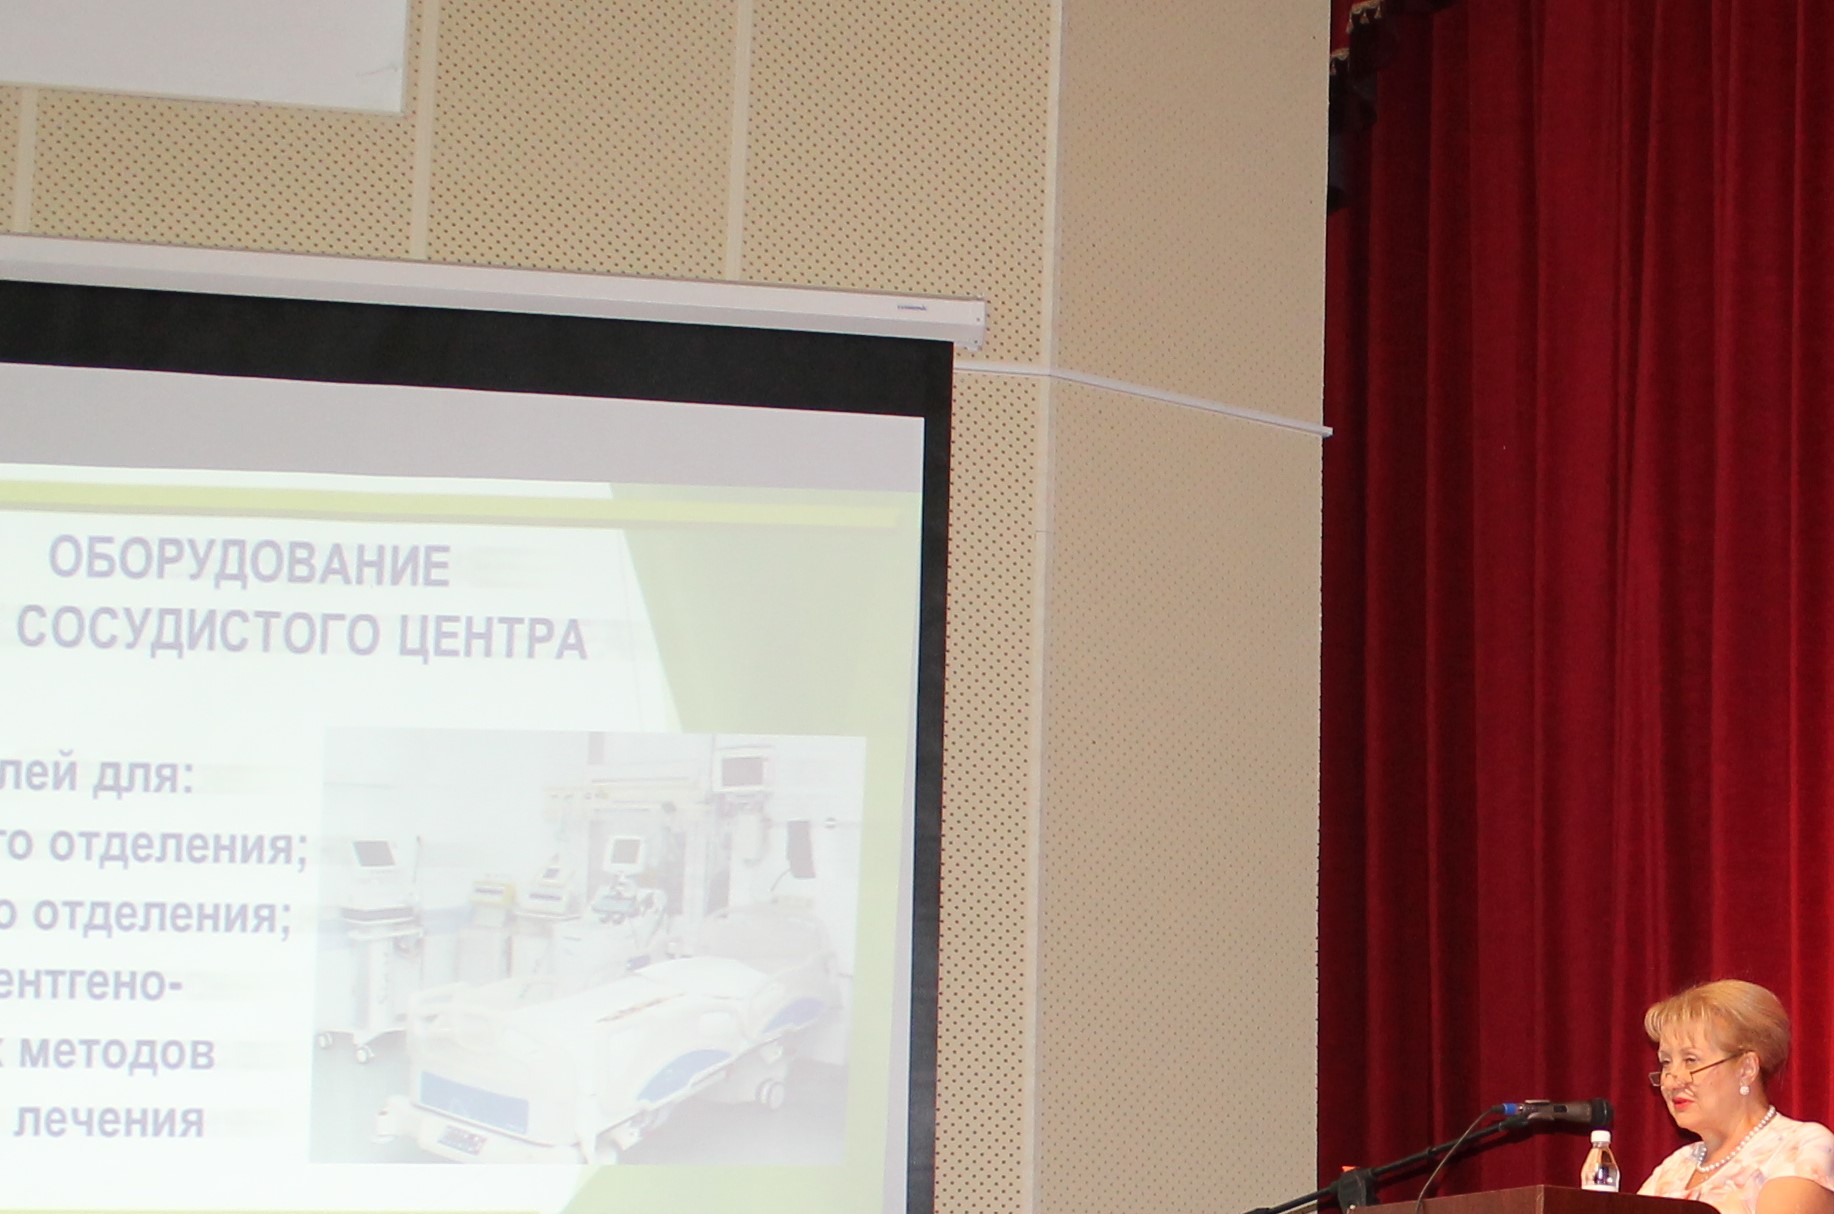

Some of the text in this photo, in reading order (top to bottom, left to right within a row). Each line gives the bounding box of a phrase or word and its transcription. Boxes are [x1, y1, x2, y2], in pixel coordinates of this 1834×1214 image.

[49, 534, 450, 590] ОБОРУДОВАНИЕ
[17, 604, 587, 665] СОСУДИСТОГО ЦЕНТРА
[93, 762, 193, 800] для:
[49, 830, 307, 872] отделения;
[33, 900, 290, 941] отделения;
[20, 1038, 215, 1076] методов
[14, 1107, 204, 1138] лечения
